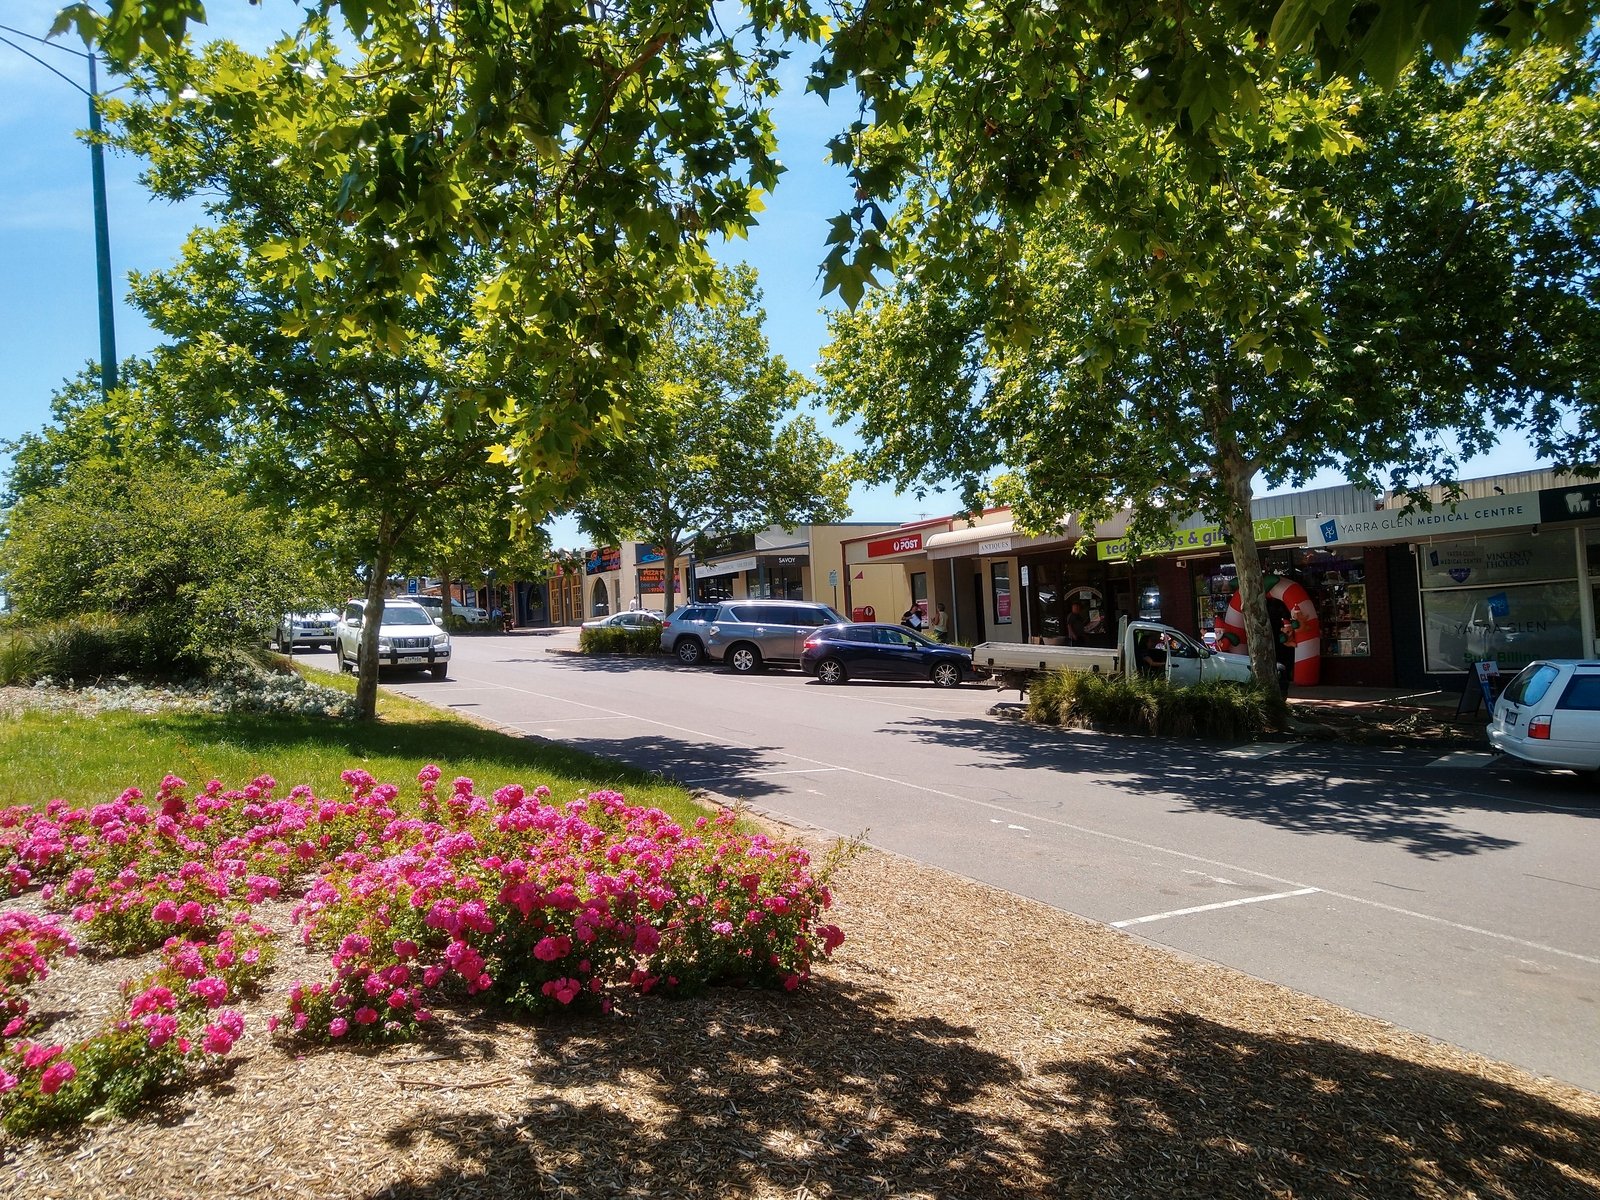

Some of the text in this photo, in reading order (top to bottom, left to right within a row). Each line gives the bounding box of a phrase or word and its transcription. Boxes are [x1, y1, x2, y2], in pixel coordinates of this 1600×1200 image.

[1341, 505, 1523, 534] YARRA GLEN MEDICAL CENTRE
[1188, 531, 1198, 545] &
[900, 539, 918, 551] POST
[981, 541, 1009, 552] ANTIQUES
[409, 579, 416, 587] P
[1507, 621, 1546, 633] GLEN
